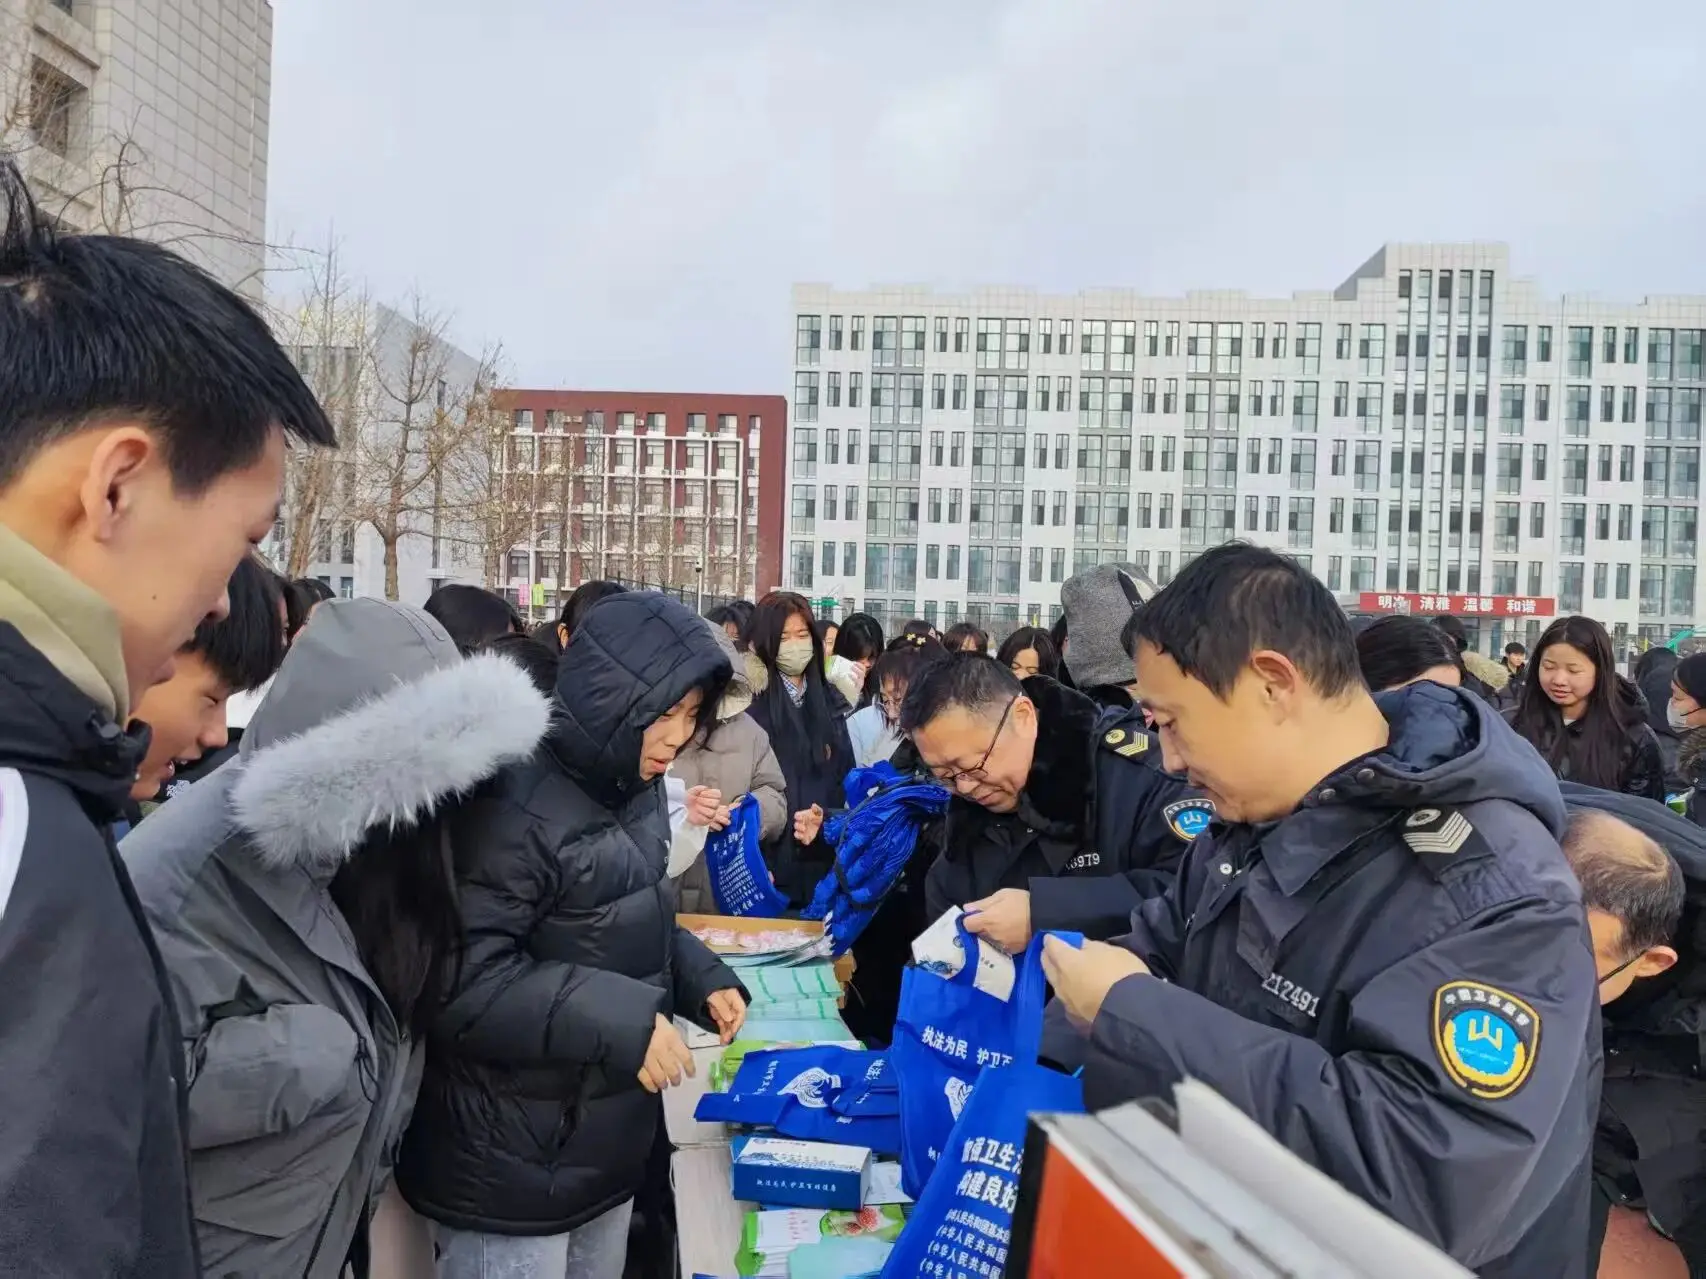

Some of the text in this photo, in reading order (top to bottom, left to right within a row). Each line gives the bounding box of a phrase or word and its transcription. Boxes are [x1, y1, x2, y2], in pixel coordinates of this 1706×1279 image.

[1420, 595, 1450, 611] 清雅
[1506, 599, 1536, 613] 和谐
[921, 1025, 969, 1060] 执法为民
